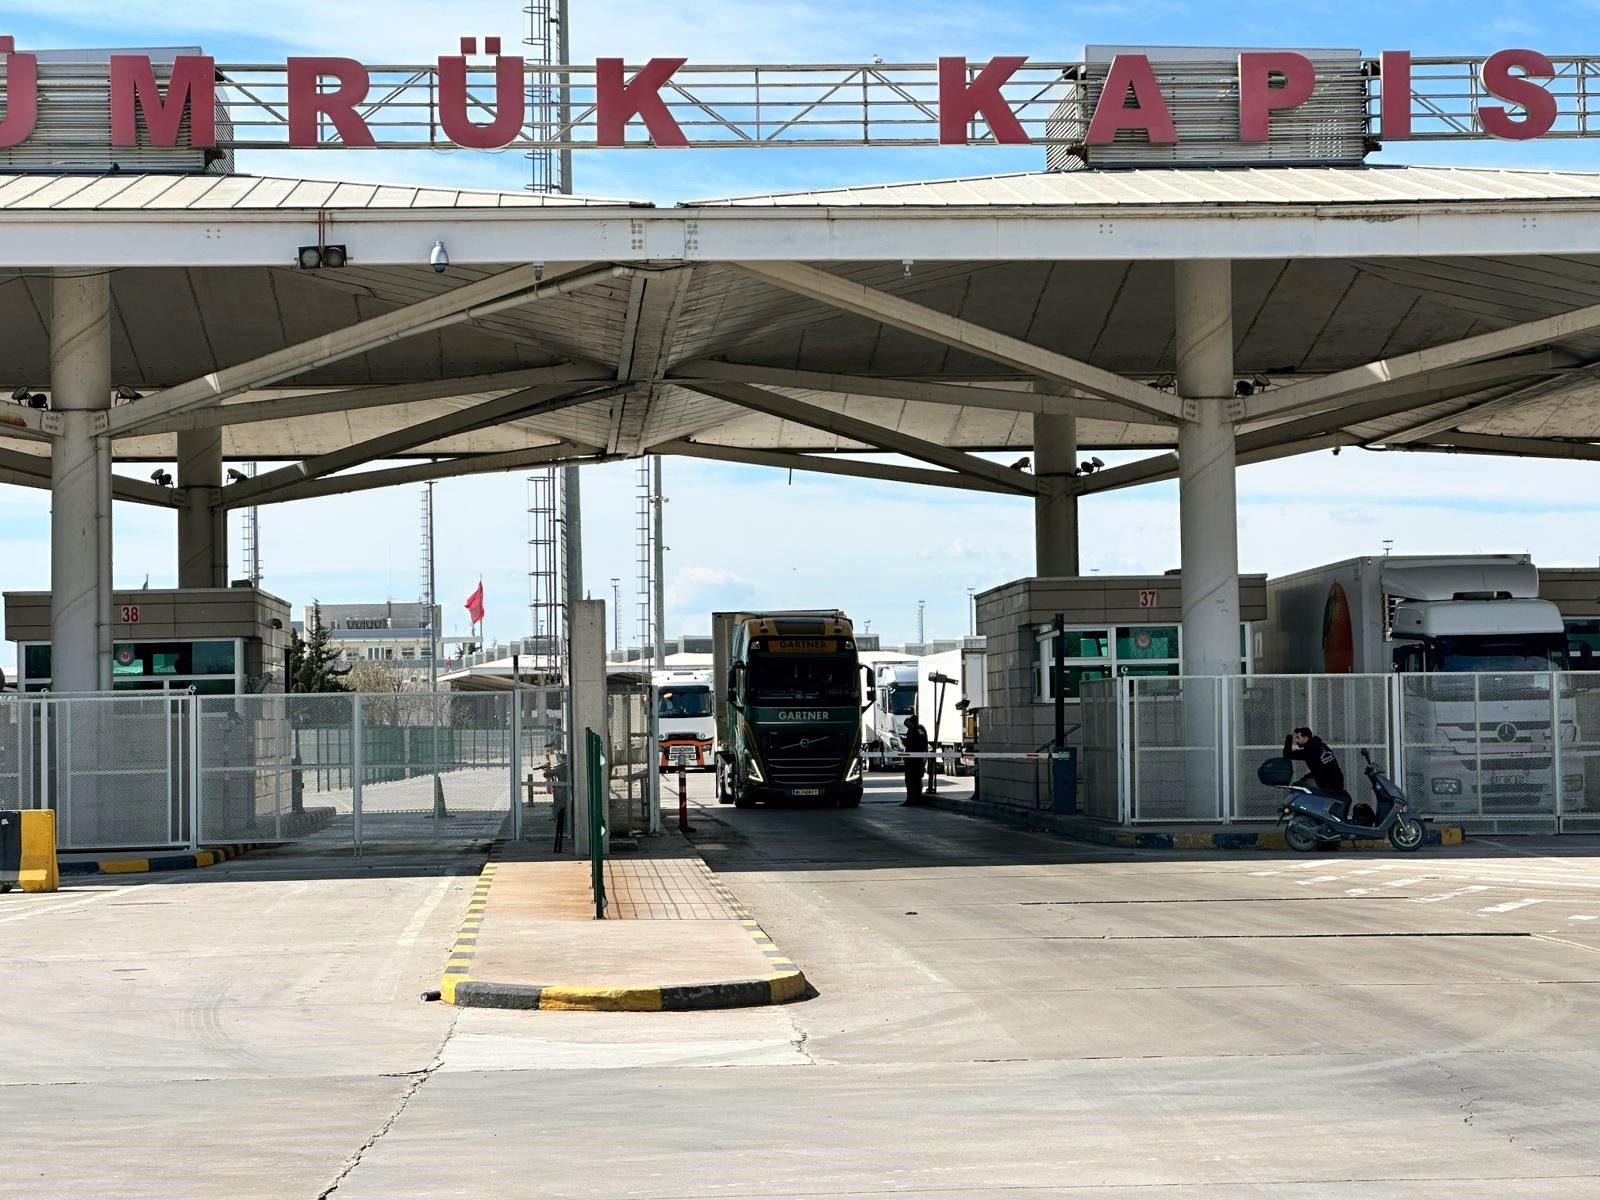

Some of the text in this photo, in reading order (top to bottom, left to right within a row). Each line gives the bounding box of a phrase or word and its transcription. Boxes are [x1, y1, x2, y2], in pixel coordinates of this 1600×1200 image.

[1140, 590, 1157, 607] 37
[122, 606, 139, 623] 38
[779, 640, 826, 649] GARTNER
[778, 711, 829, 720] GARTNER
